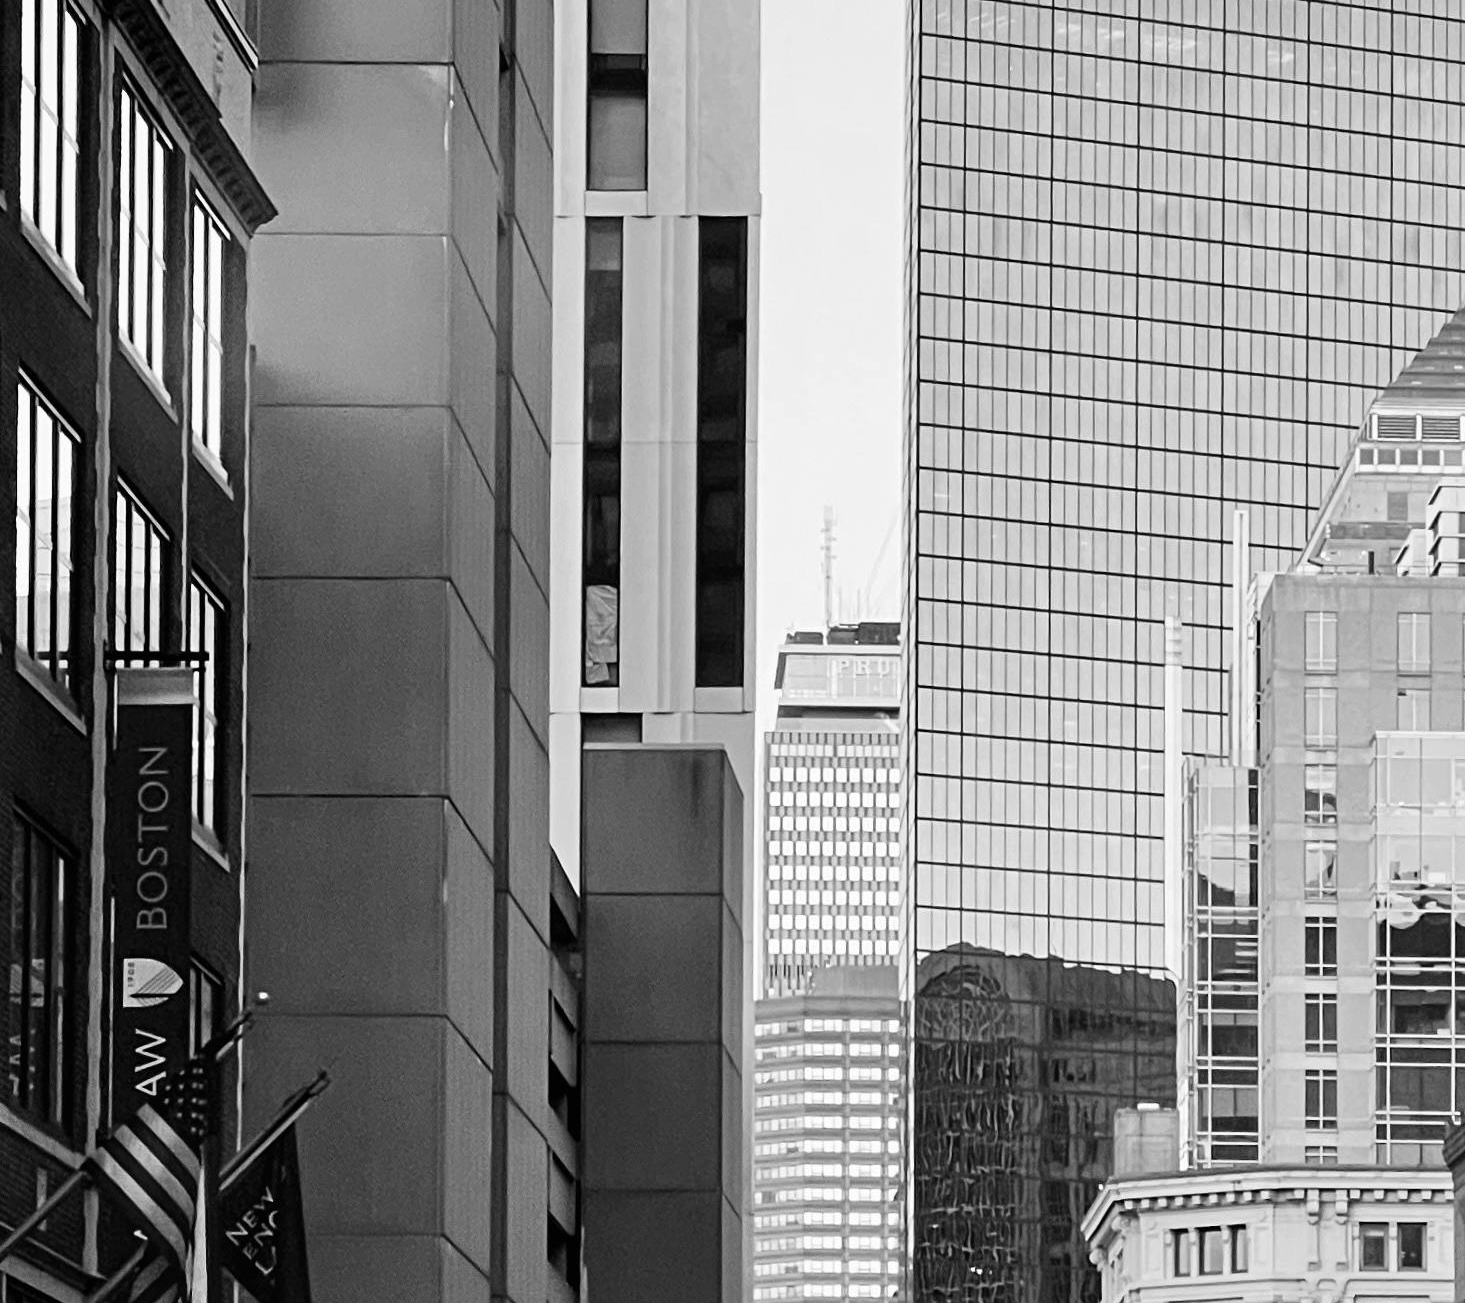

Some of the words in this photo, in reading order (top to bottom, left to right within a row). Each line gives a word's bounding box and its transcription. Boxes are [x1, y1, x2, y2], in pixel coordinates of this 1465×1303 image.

[136, 746, 169, 930] BOSTON
[134, 1028, 167, 1096] AW
[226, 1185, 274, 1246] NEW
